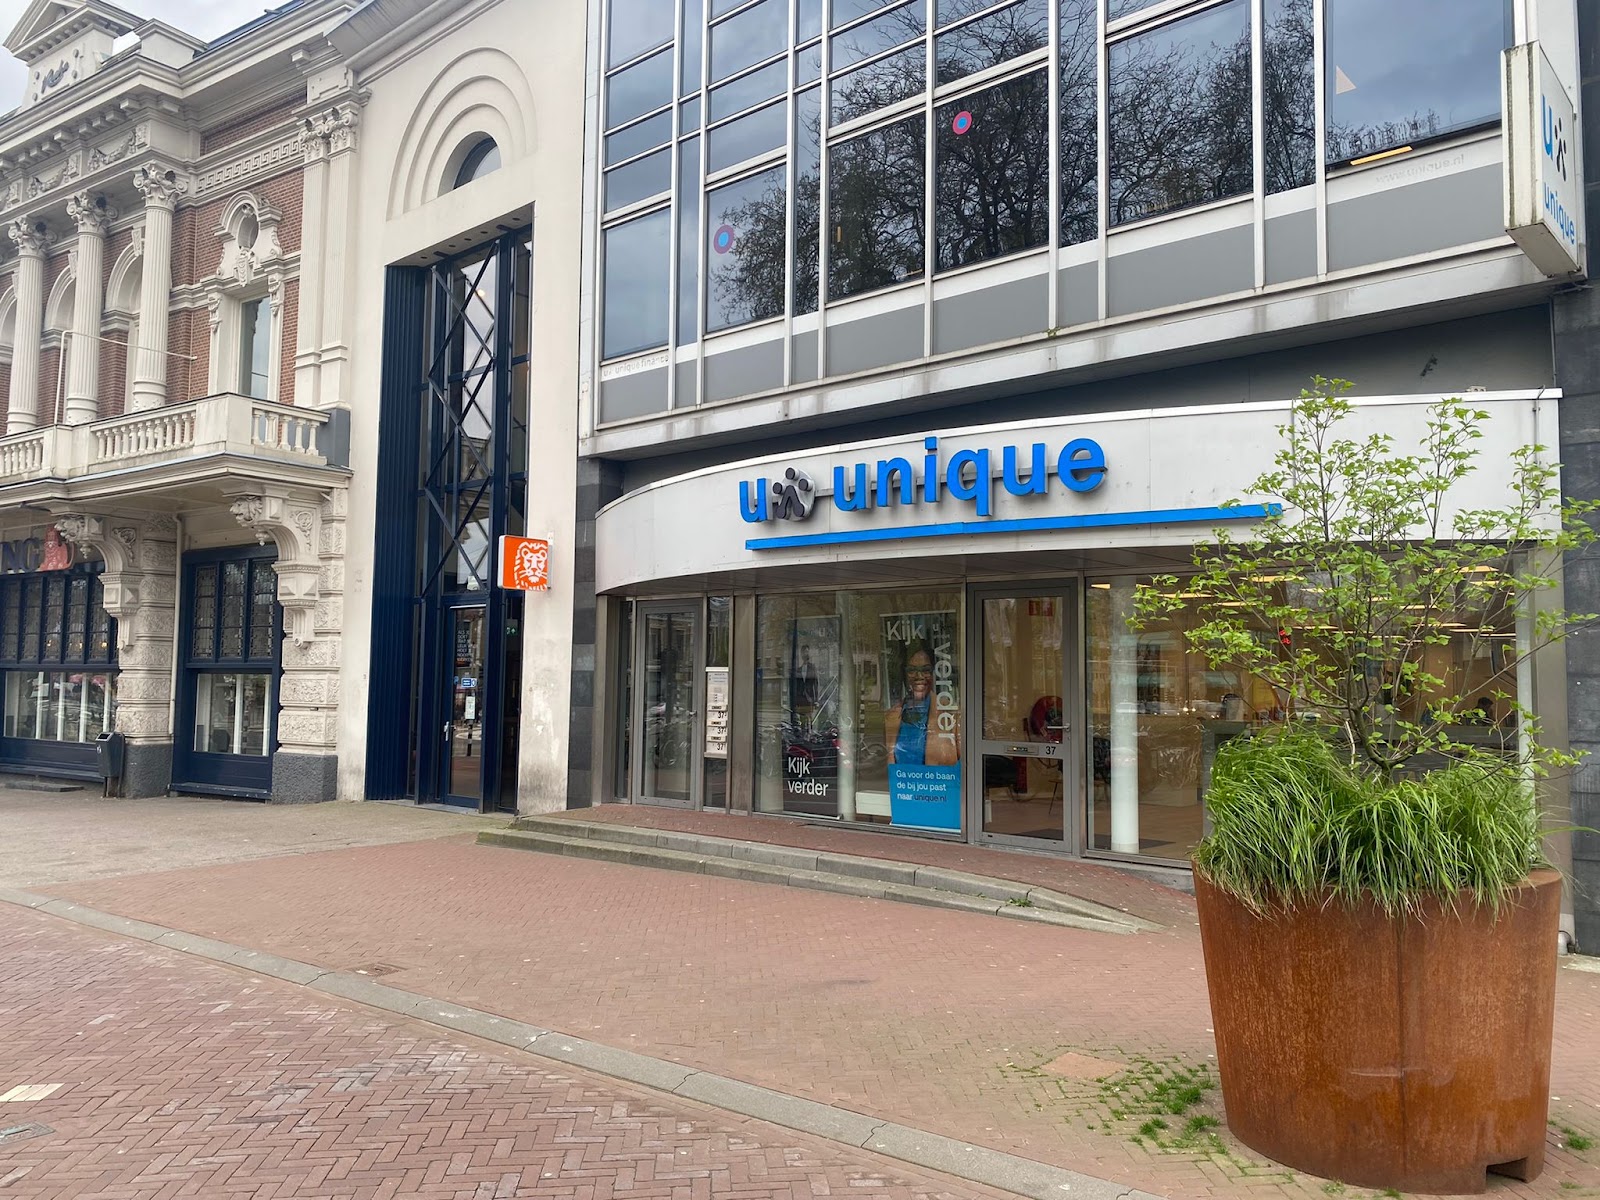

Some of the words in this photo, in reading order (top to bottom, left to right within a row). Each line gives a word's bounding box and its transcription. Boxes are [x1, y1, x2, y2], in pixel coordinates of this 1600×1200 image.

[1544, 181, 1576, 245] unique
[834, 436, 1107, 517] unique
[887, 619, 925, 646] Kijk
[934, 641, 959, 746] verder
[1045, 745, 1056, 755] 37
[788, 756, 810, 778] Kijk
[896, 769, 906, 778] Ga
[907, 771, 923, 779] voor
[924, 771, 934, 779] de
[936, 771, 956, 780] baan
[787, 778, 829, 796] verder
[896, 781, 906, 789] de
[907, 782, 916, 791] bij
[916, 782, 928, 792] jou
[929, 783, 947, 792] past
[896, 792, 913, 800] naar
